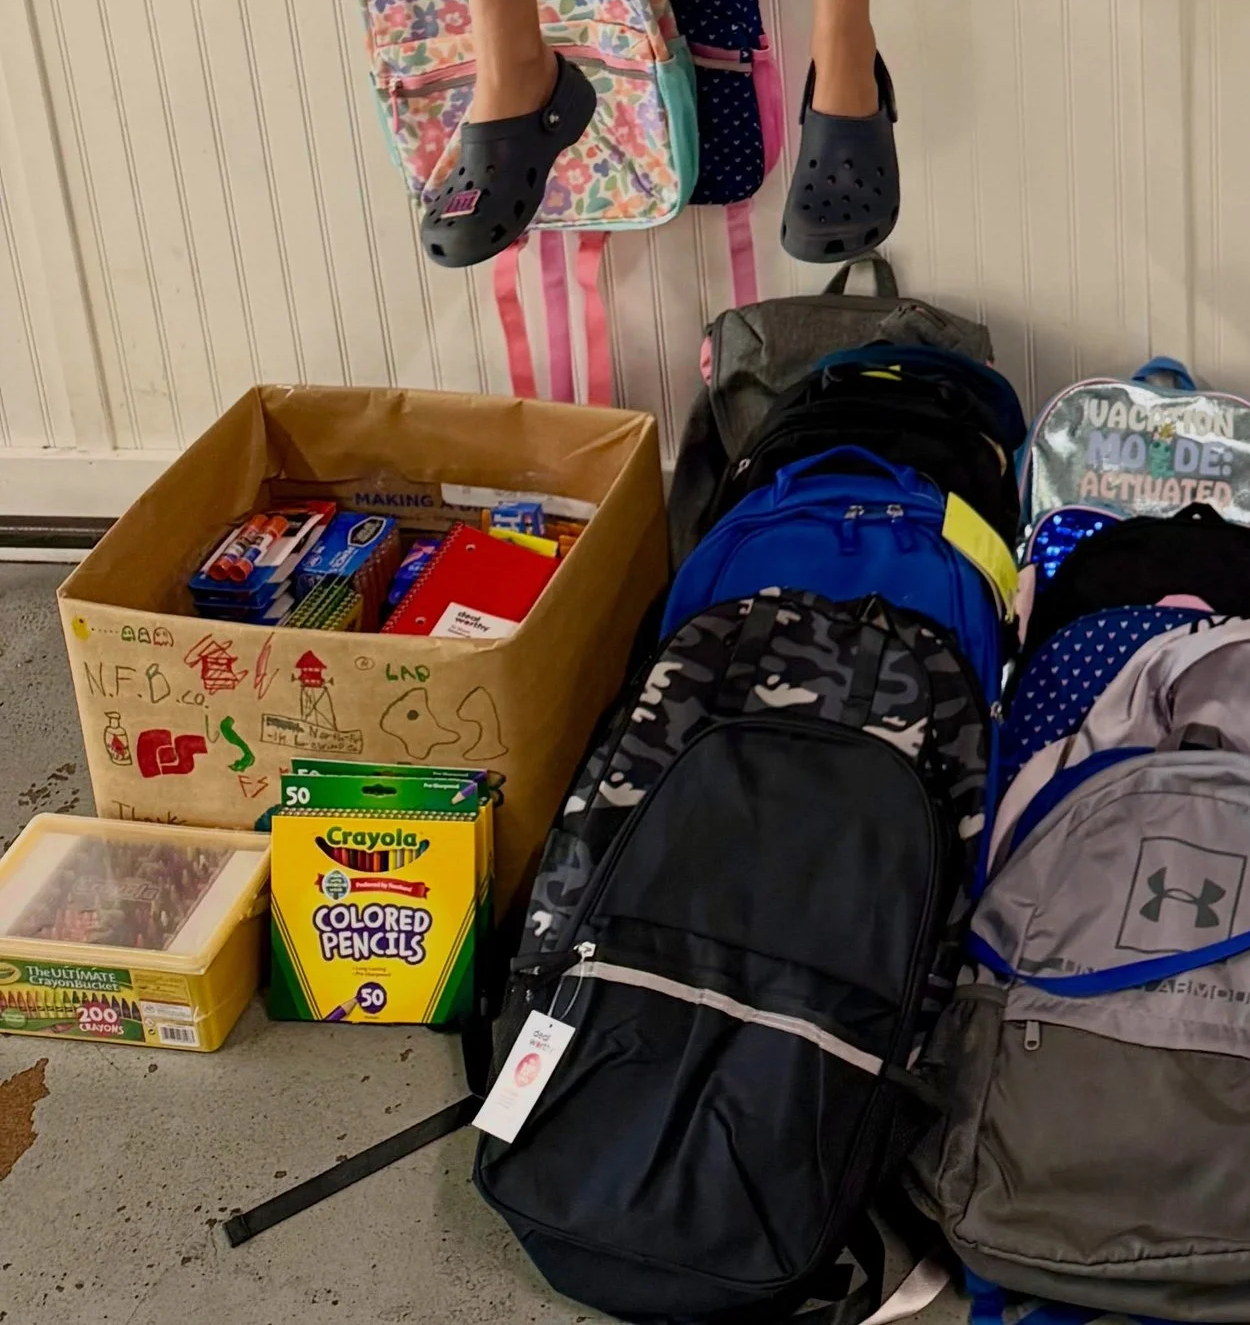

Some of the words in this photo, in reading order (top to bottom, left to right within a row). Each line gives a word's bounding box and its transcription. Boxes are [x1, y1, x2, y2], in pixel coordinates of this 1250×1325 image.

[1079, 470, 1233, 508] ACTIVATED
[354, 492, 435, 509] MAKING
[285, 786, 311, 806] 50
[326, 826, 418, 852] Crayola
[313, 903, 433, 933] COLORED
[320, 929, 426, 965] PENCILS
[26, 965, 50, 977] The
[50, 966, 117, 982] ULTIMATE
[360, 988, 384, 1007] 50
[78, 1007, 119, 1023] 200
[78, 1023, 125, 1036] CRAYONS
